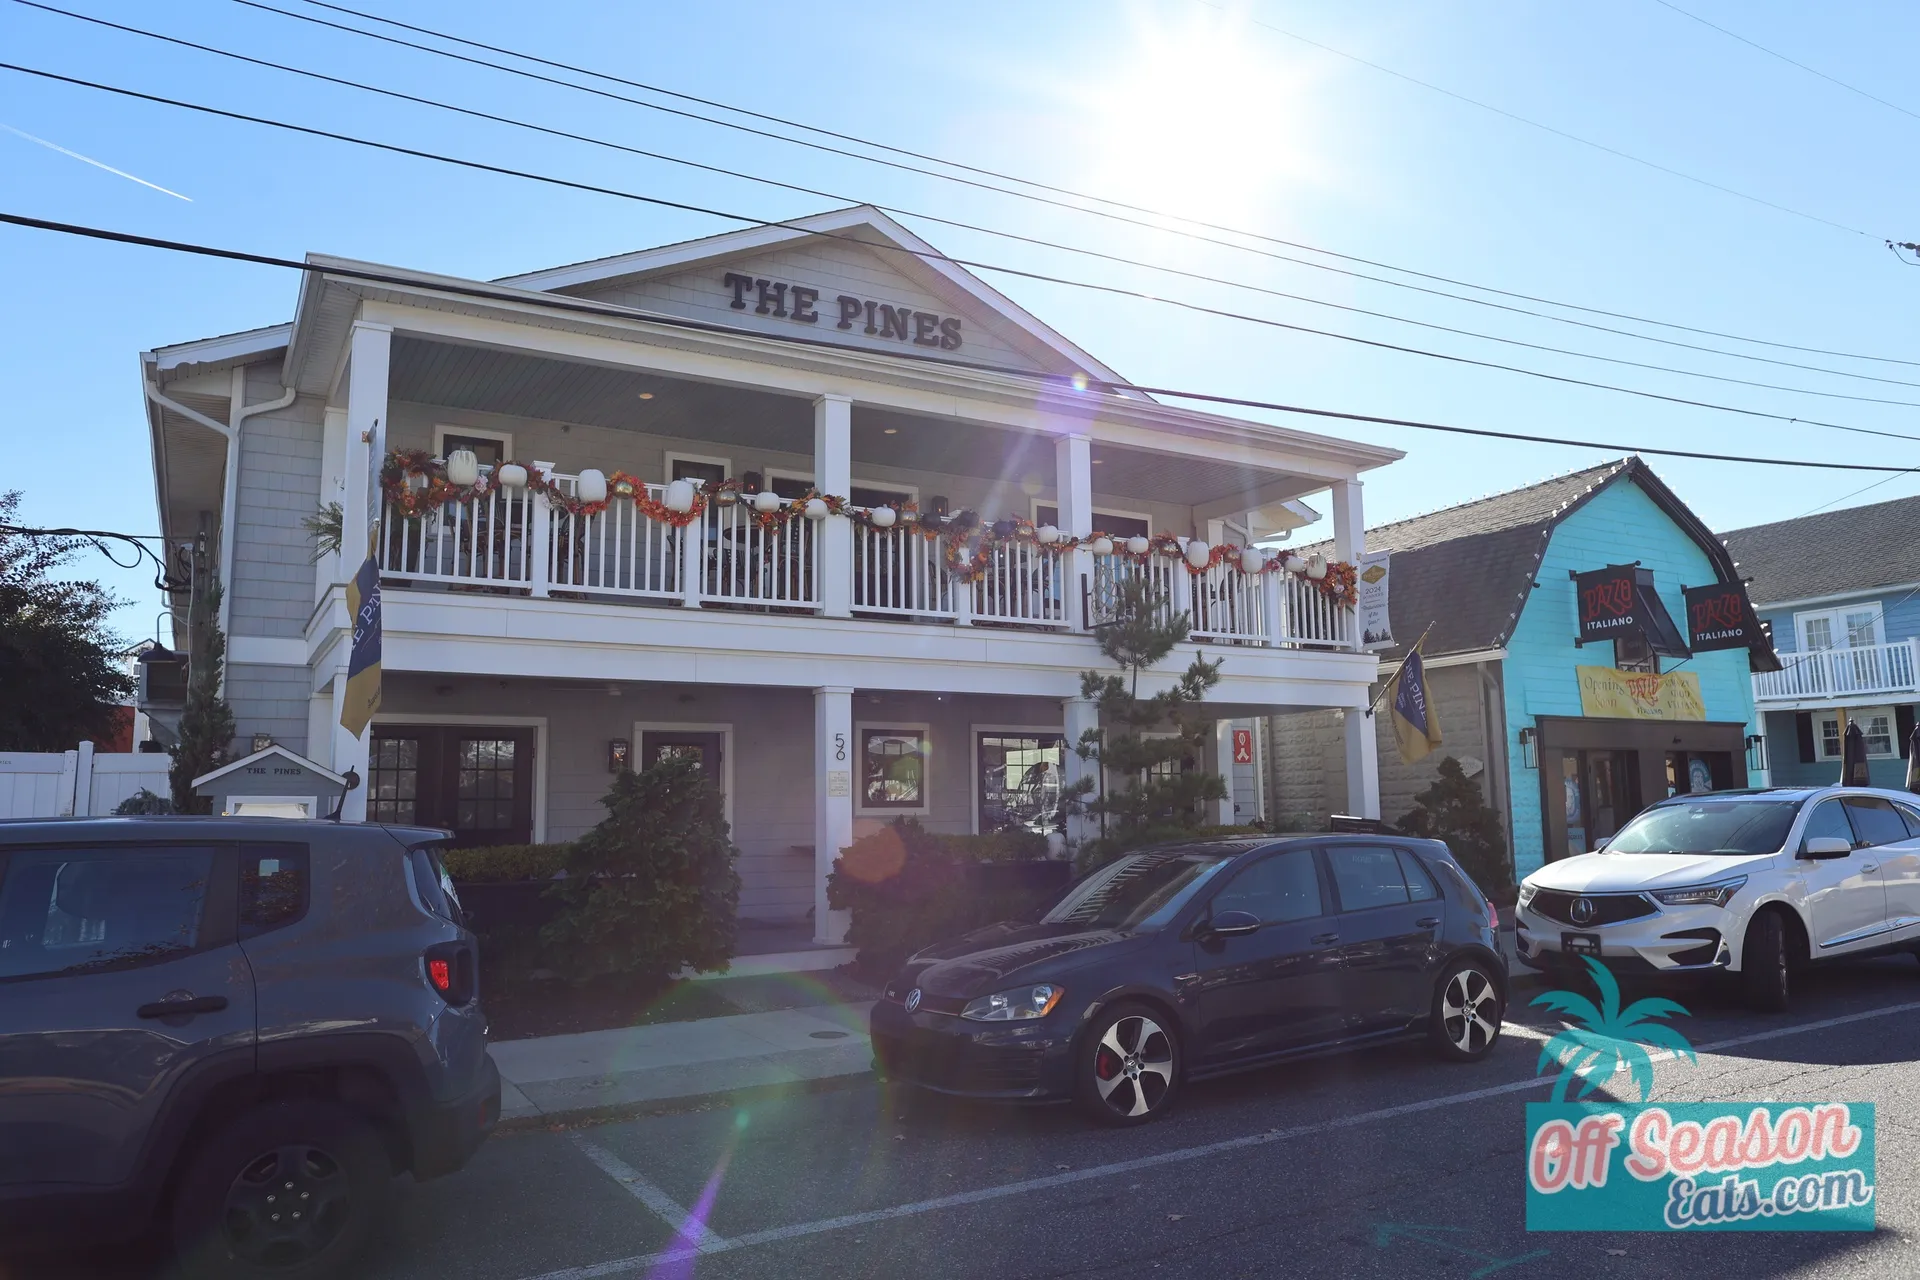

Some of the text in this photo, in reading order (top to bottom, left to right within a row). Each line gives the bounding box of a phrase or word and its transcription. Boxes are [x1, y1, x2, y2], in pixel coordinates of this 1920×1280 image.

[724, 272, 963, 350] THE PINES
[1365, 586, 1381, 595] 2024
[1583, 578, 1633, 622] PAZZO
[1692, 594, 1743, 633] PAZZO
[1587, 616, 1634, 630] ITALIANO
[1696, 628, 1743, 641] ITALIANO
[1584, 676, 1625, 695] Opening
[1595, 694, 1617, 709] Soon
[835, 733, 846, 761] 56
[246, 767, 301, 775] THE PINES
